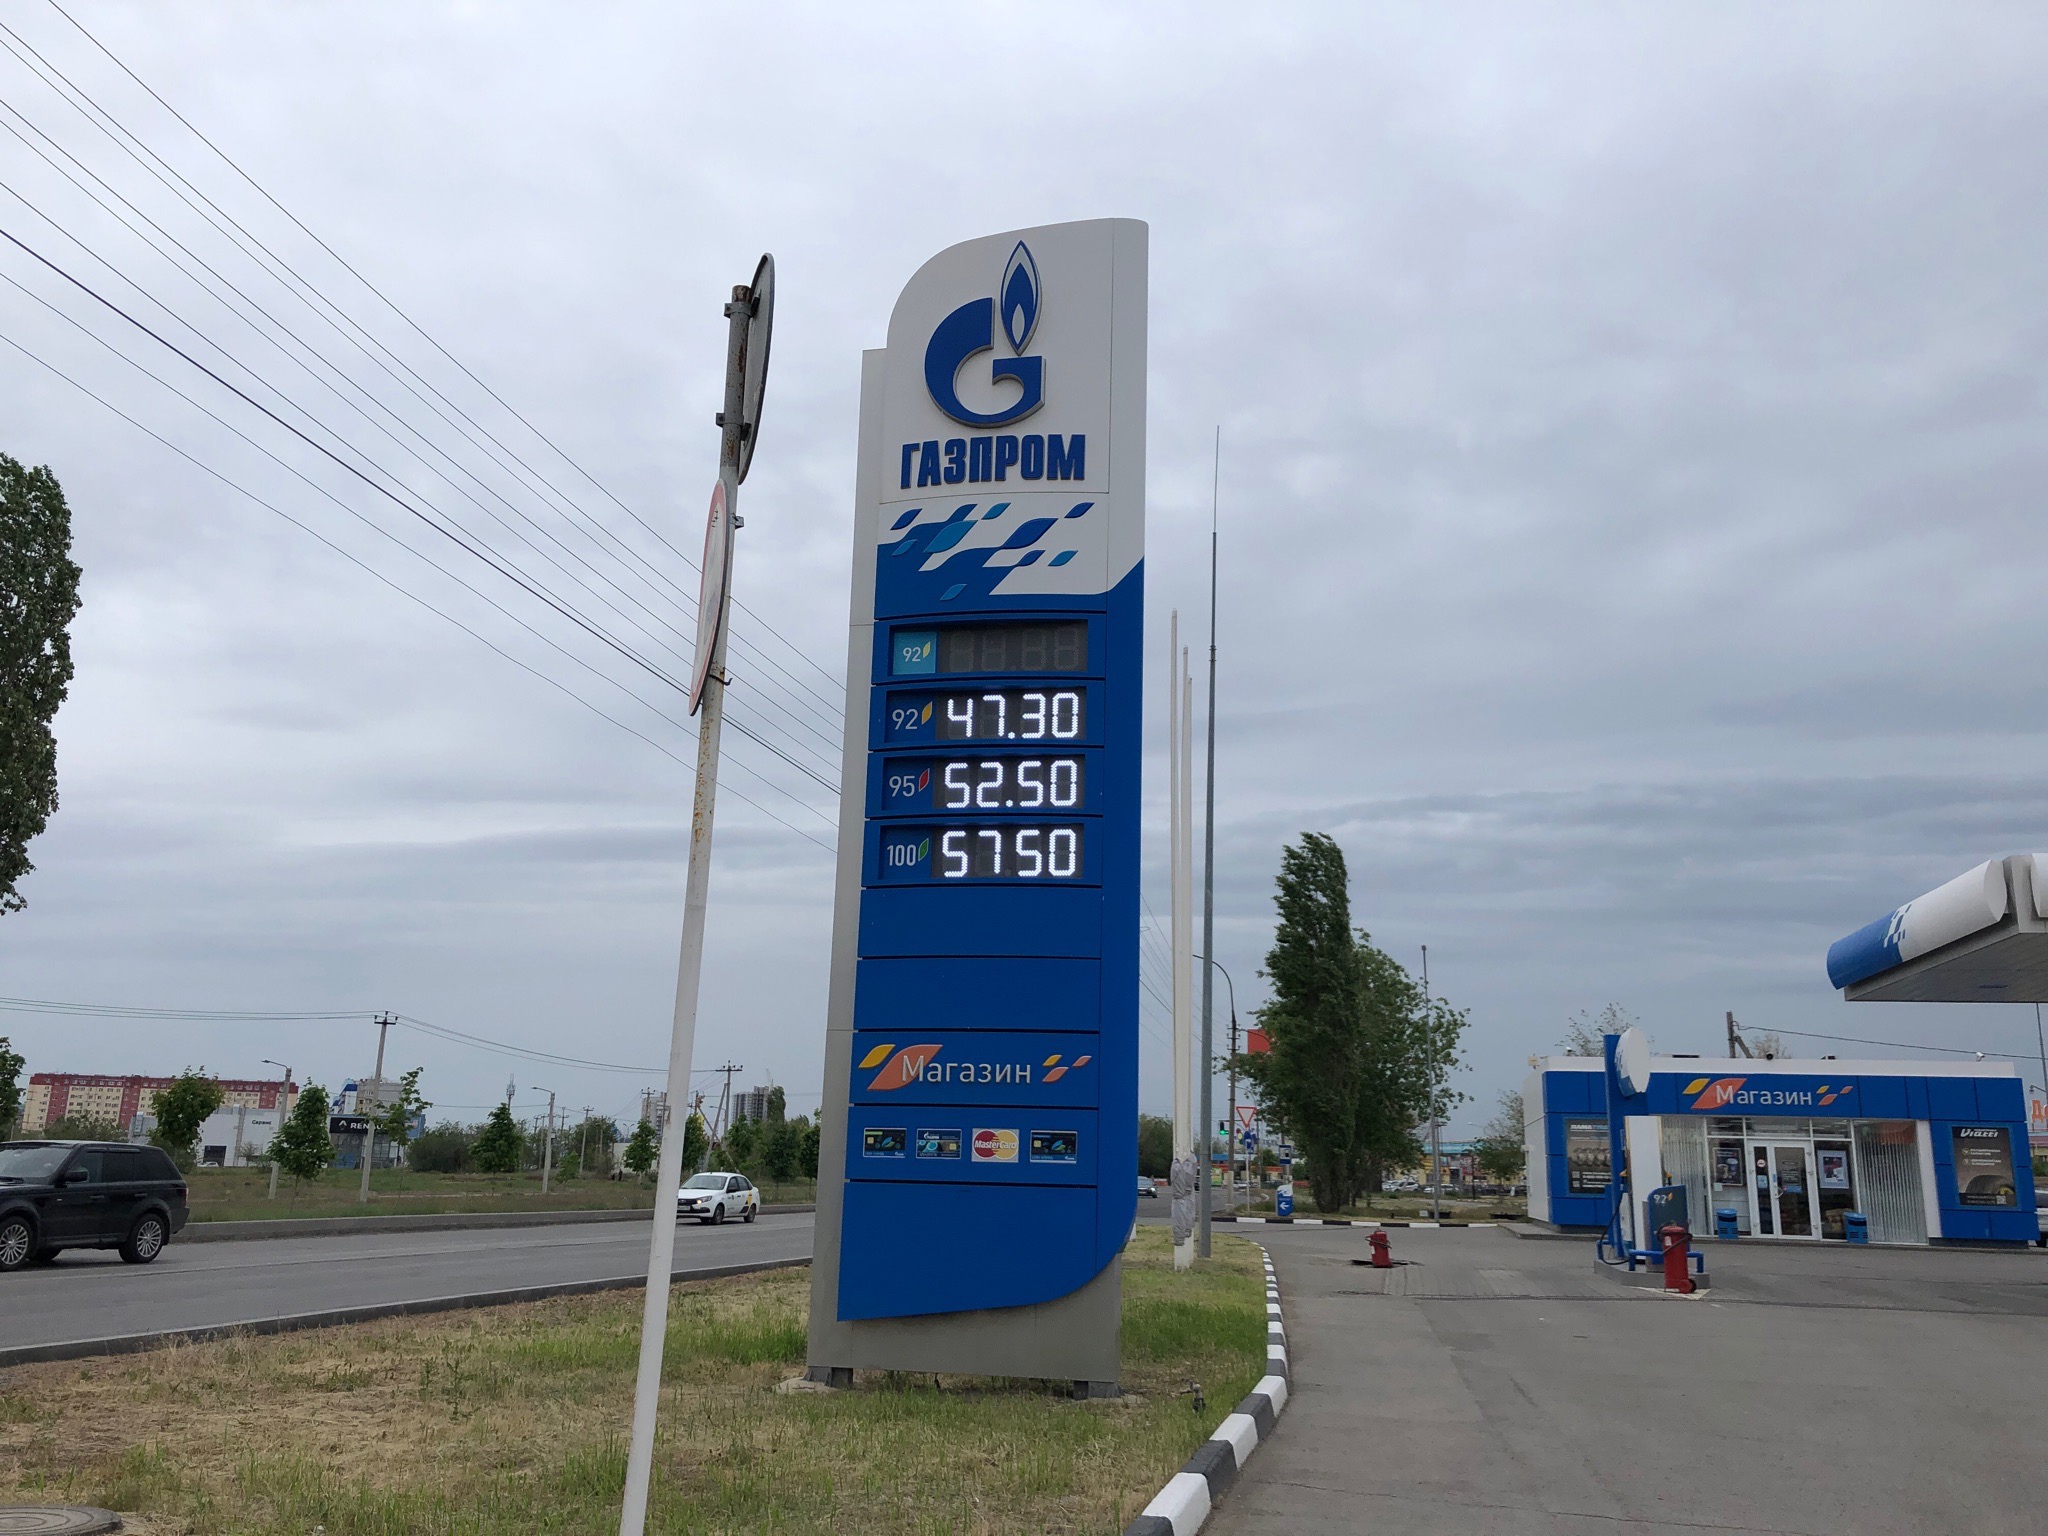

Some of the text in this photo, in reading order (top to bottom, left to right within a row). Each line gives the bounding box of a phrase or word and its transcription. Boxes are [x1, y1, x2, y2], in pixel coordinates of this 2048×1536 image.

[900, 433, 1086, 490] ГАЗПРОМ
[902, 647, 921, 662] 92
[892, 692, 1079, 739] 92 47.30
[888, 759, 1077, 808] 95 52.50
[886, 844, 917, 866] 100
[902, 1055, 1031, 1084] Магазин
[1715, 1085, 1812, 1106] Магазин
[974, 1140, 1017, 1149] MasterCard
[1653, 1194, 1667, 1204] 92
